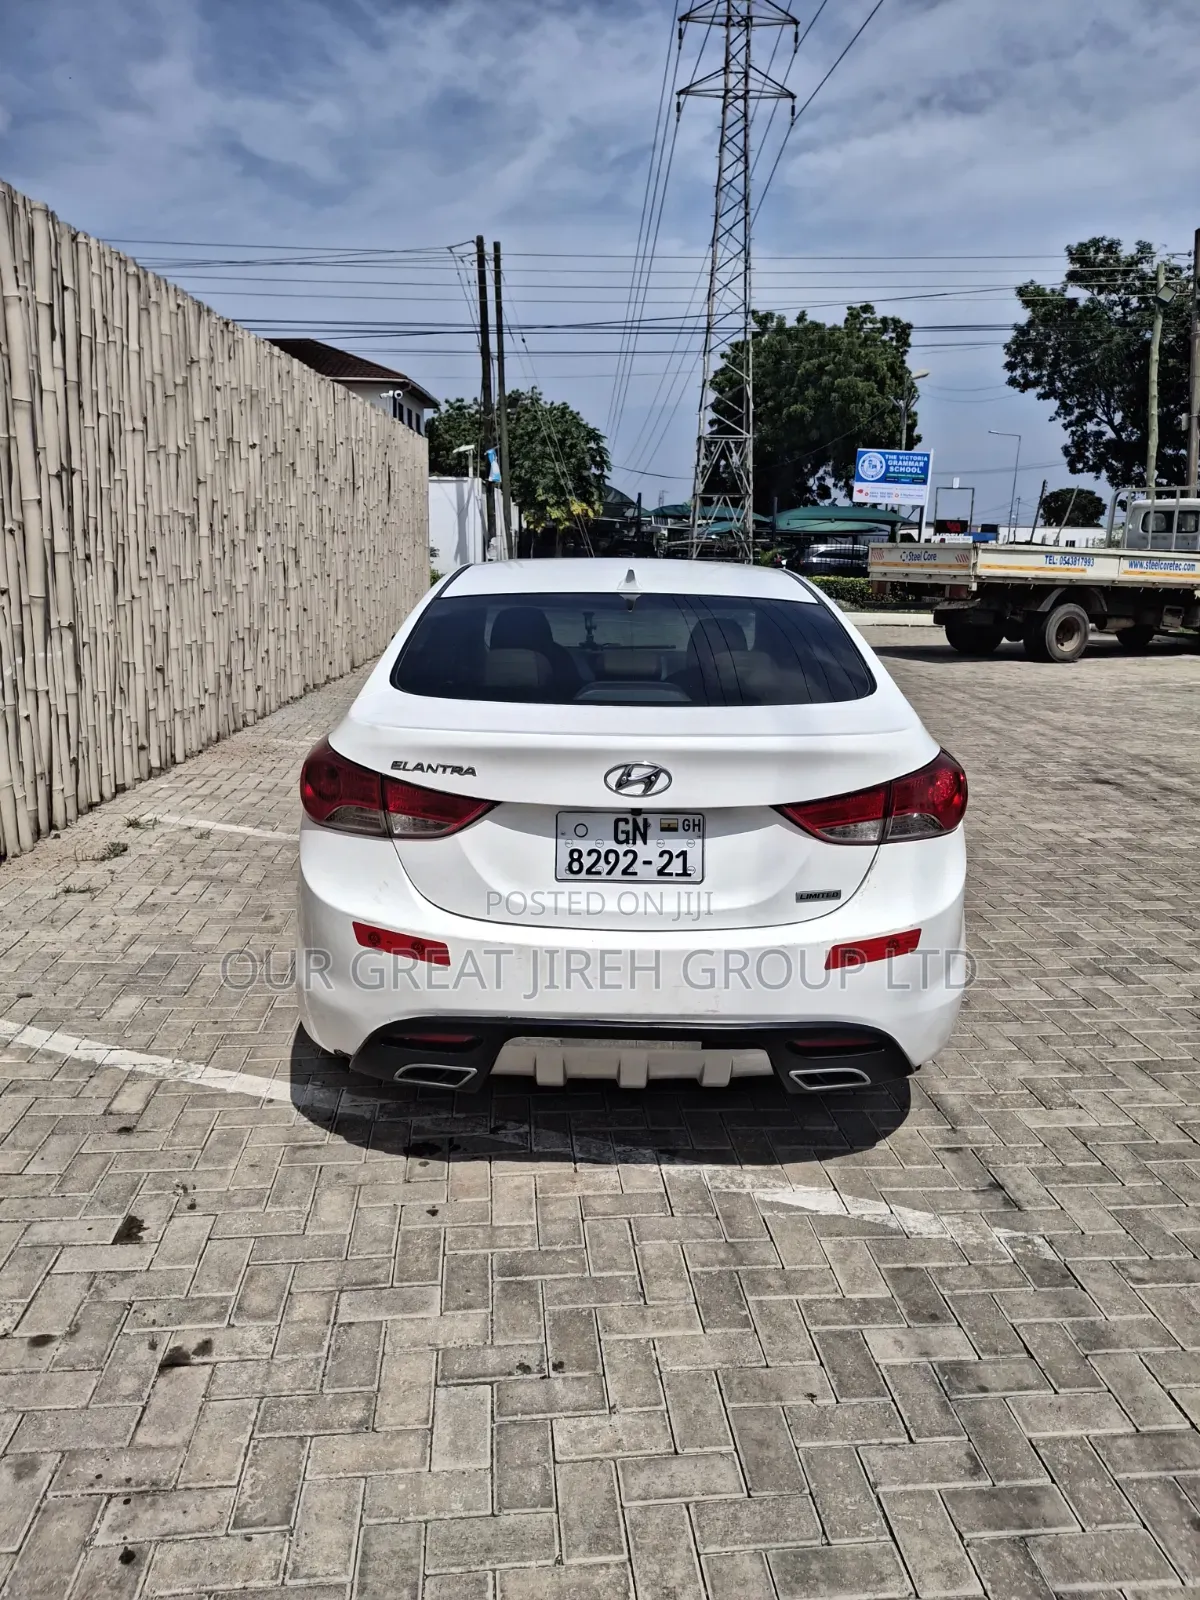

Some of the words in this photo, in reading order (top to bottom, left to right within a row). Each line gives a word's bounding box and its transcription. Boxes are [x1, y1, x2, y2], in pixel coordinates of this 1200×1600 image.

[908, 551, 922, 562] Steel
[923, 551, 937, 561] Core
[1044, 555, 1058, 565] TEL:
[390, 760, 477, 777] ELANTRA
[613, 817, 648, 846] GN
[682, 818, 701, 832] GH
[567, 848, 692, 877] 8292-21
[799, 891, 839, 900] LIMITED
